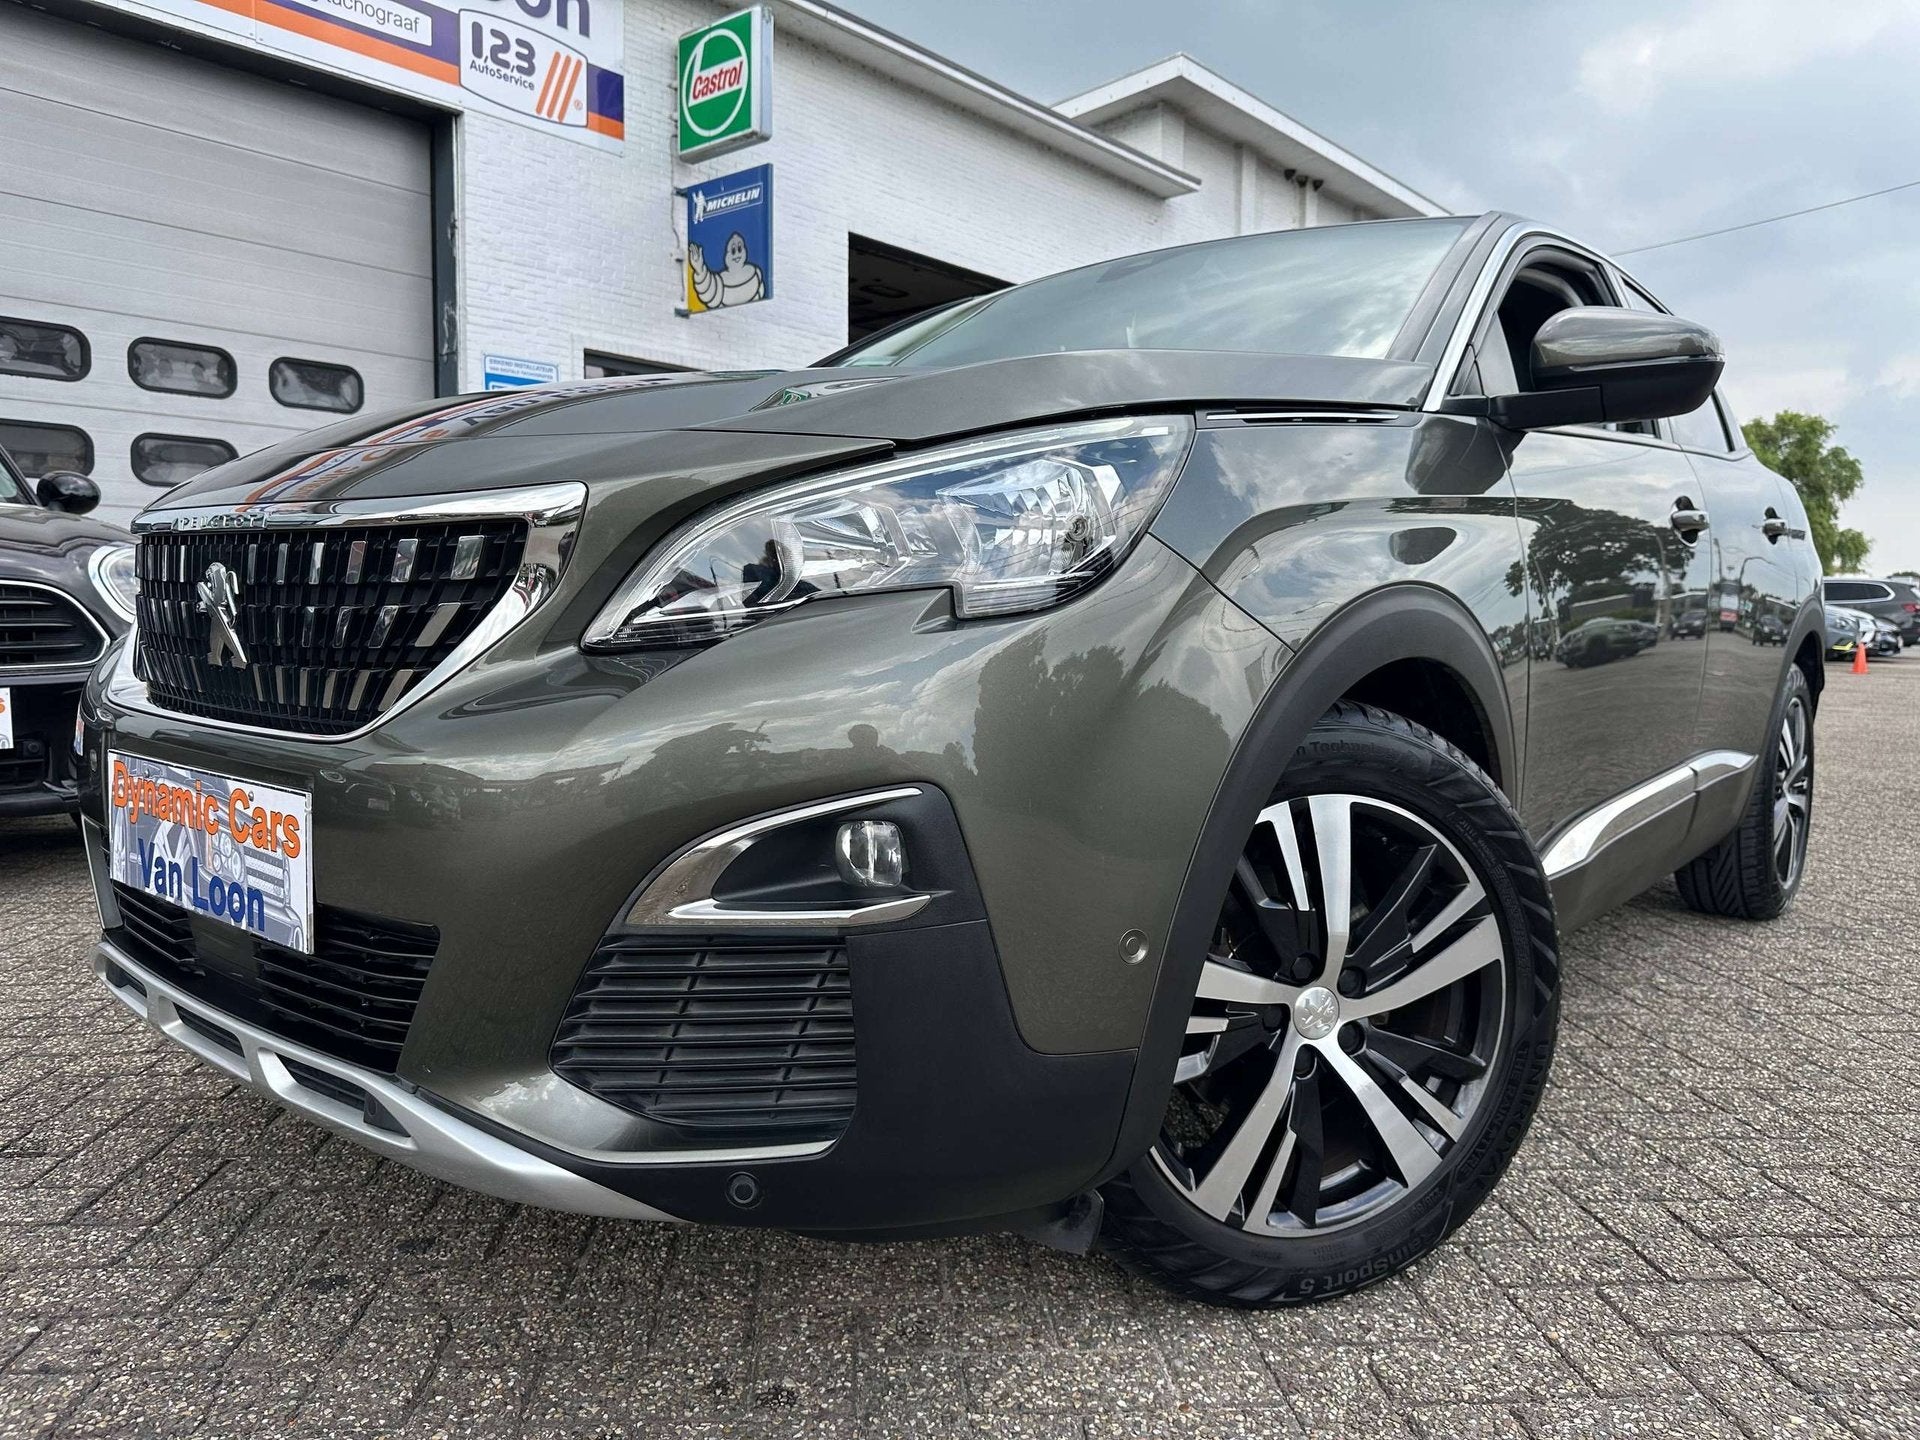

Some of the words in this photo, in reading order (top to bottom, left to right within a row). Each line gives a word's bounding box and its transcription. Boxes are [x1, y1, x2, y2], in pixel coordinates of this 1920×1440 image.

[469, 59, 535, 91] AutoService
[692, 60, 744, 100] Castrol
[706, 187, 760, 211] MICHELIN
[180, 514, 259, 530] PEUGEOT
[113, 760, 220, 836] Dynamic
[229, 787, 301, 859] Cars
[138, 838, 182, 900] Van
[191, 856, 265, 932] Loon
[1299, 1277, 1315, 1294] 5
